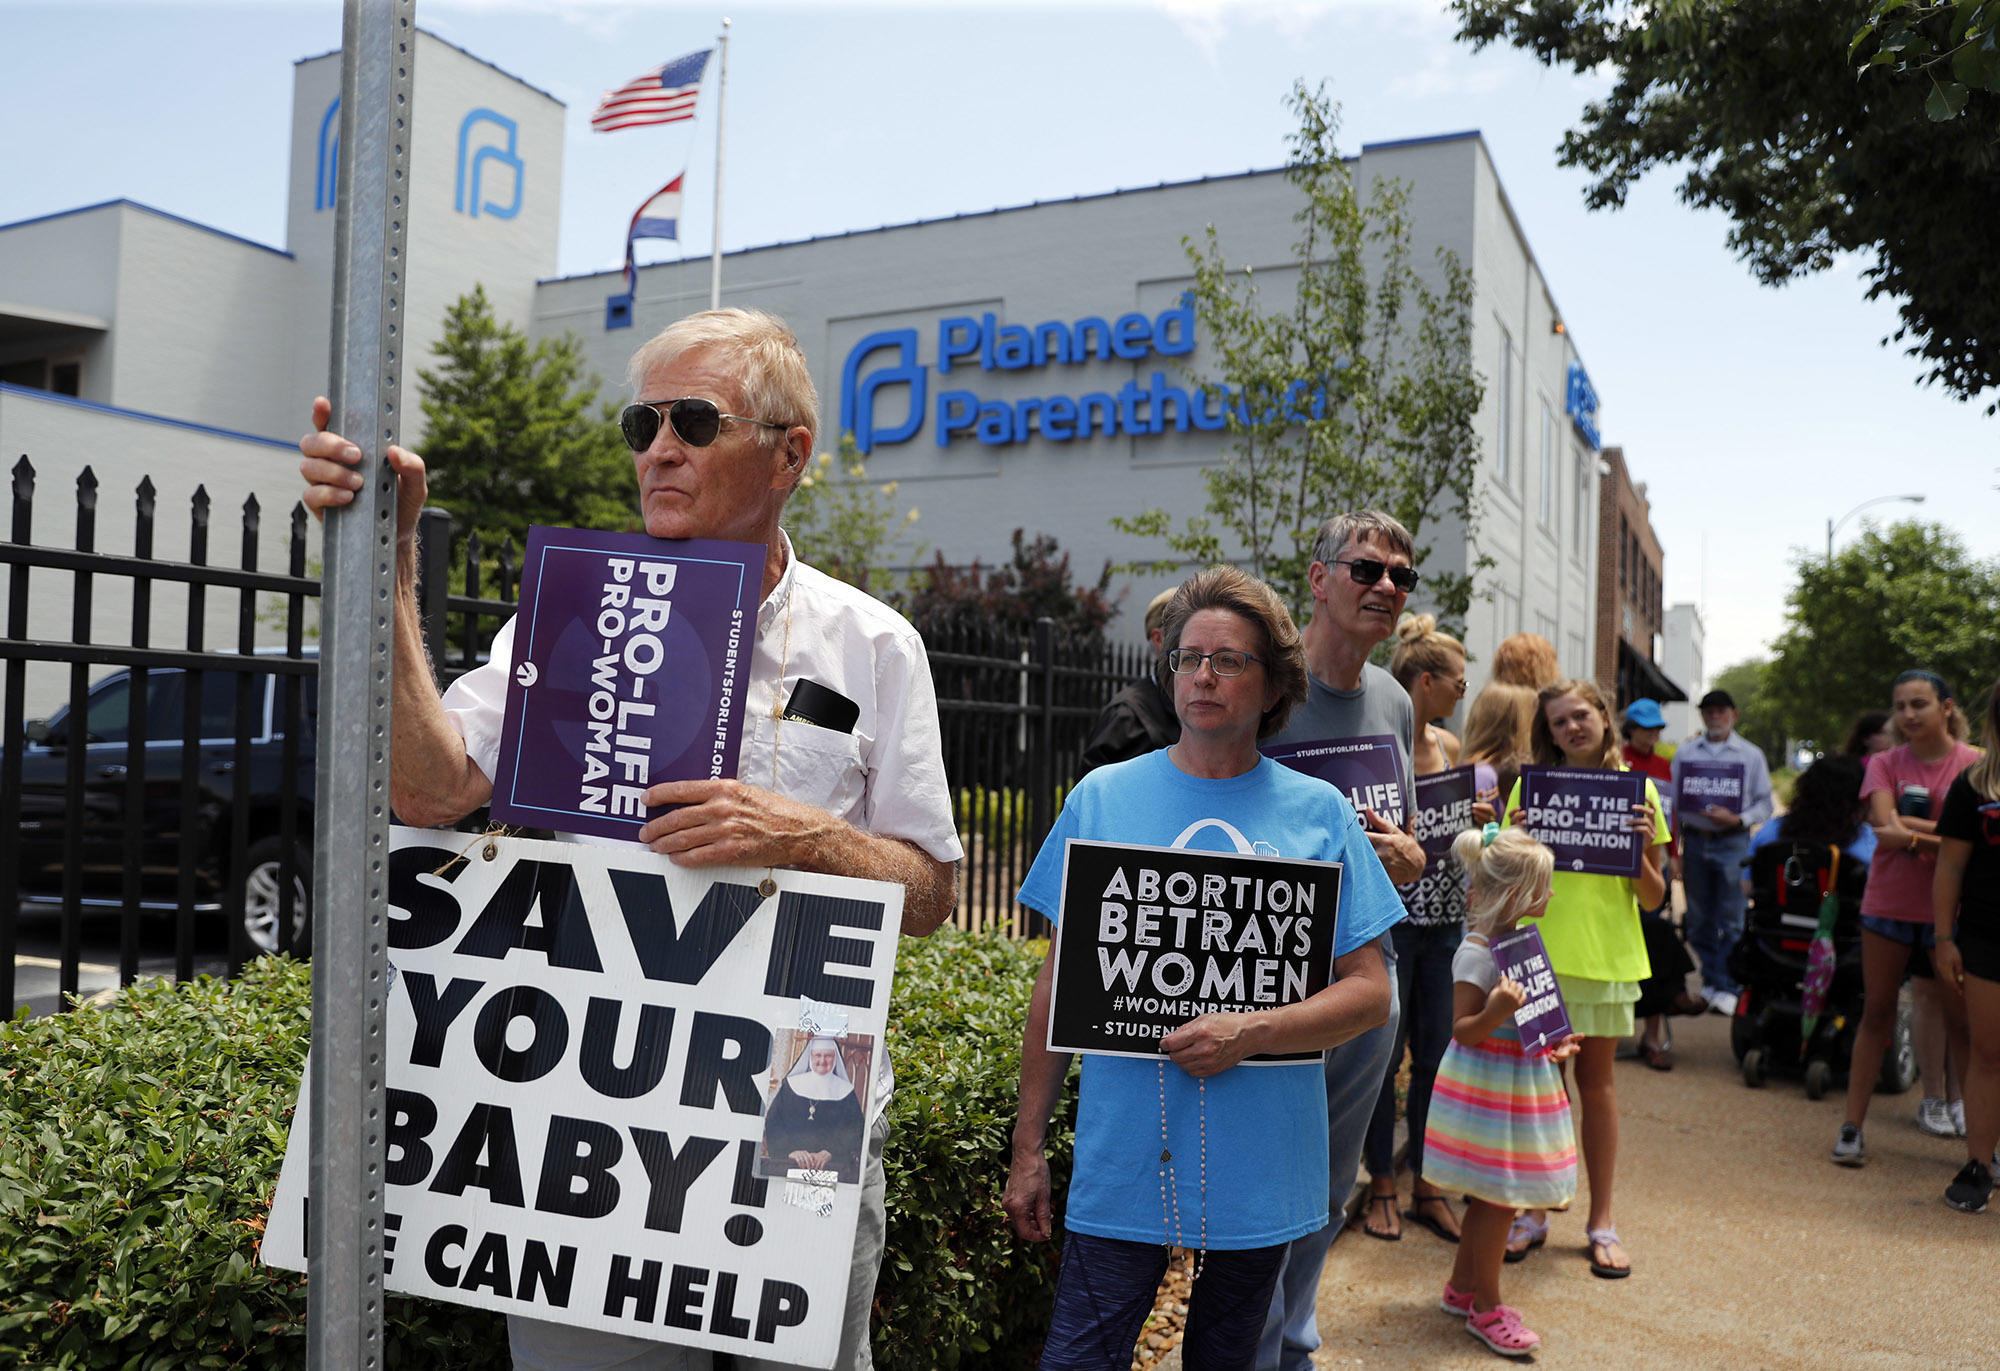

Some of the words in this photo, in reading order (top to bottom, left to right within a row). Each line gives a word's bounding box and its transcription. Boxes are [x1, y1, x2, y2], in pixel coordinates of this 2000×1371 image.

[937, 291, 1196, 374] Planned
[579, 557, 635, 814] PRO-WOMAN
[611, 561, 678, 819] PRO-LIFE
[1296, 743, 1374, 758] STUDENTSFORLIFE.ORG
[1345, 782, 1401, 811] -LIFE
[1415, 798, 1472, 827] RO-LIFE
[1527, 807, 1635, 832] PRO-LIFE
[1533, 792, 1540, 806] I
[1547, 793, 1580, 809] AM
[1589, 796, 1629, 812] THE
[1414, 817, 1473, 841] O-WOMAN
[1528, 828, 1632, 850] GENERATION
[1102, 866, 1316, 915] ABORTION
[388, 846, 886, 1009] SAVE
[1098, 901, 1313, 957] BETRAYS
[1097, 947, 1310, 1004] WOMEN
[1524, 953, 1546, 975] THE
[401, 970, 774, 1117] YOUR
[1104, 1021, 1176, 1039] STUDEN
[385, 1091, 769, 1247] BABY!
[423, 1223, 578, 1309] CAN
[603, 1254, 810, 1344] HELP
